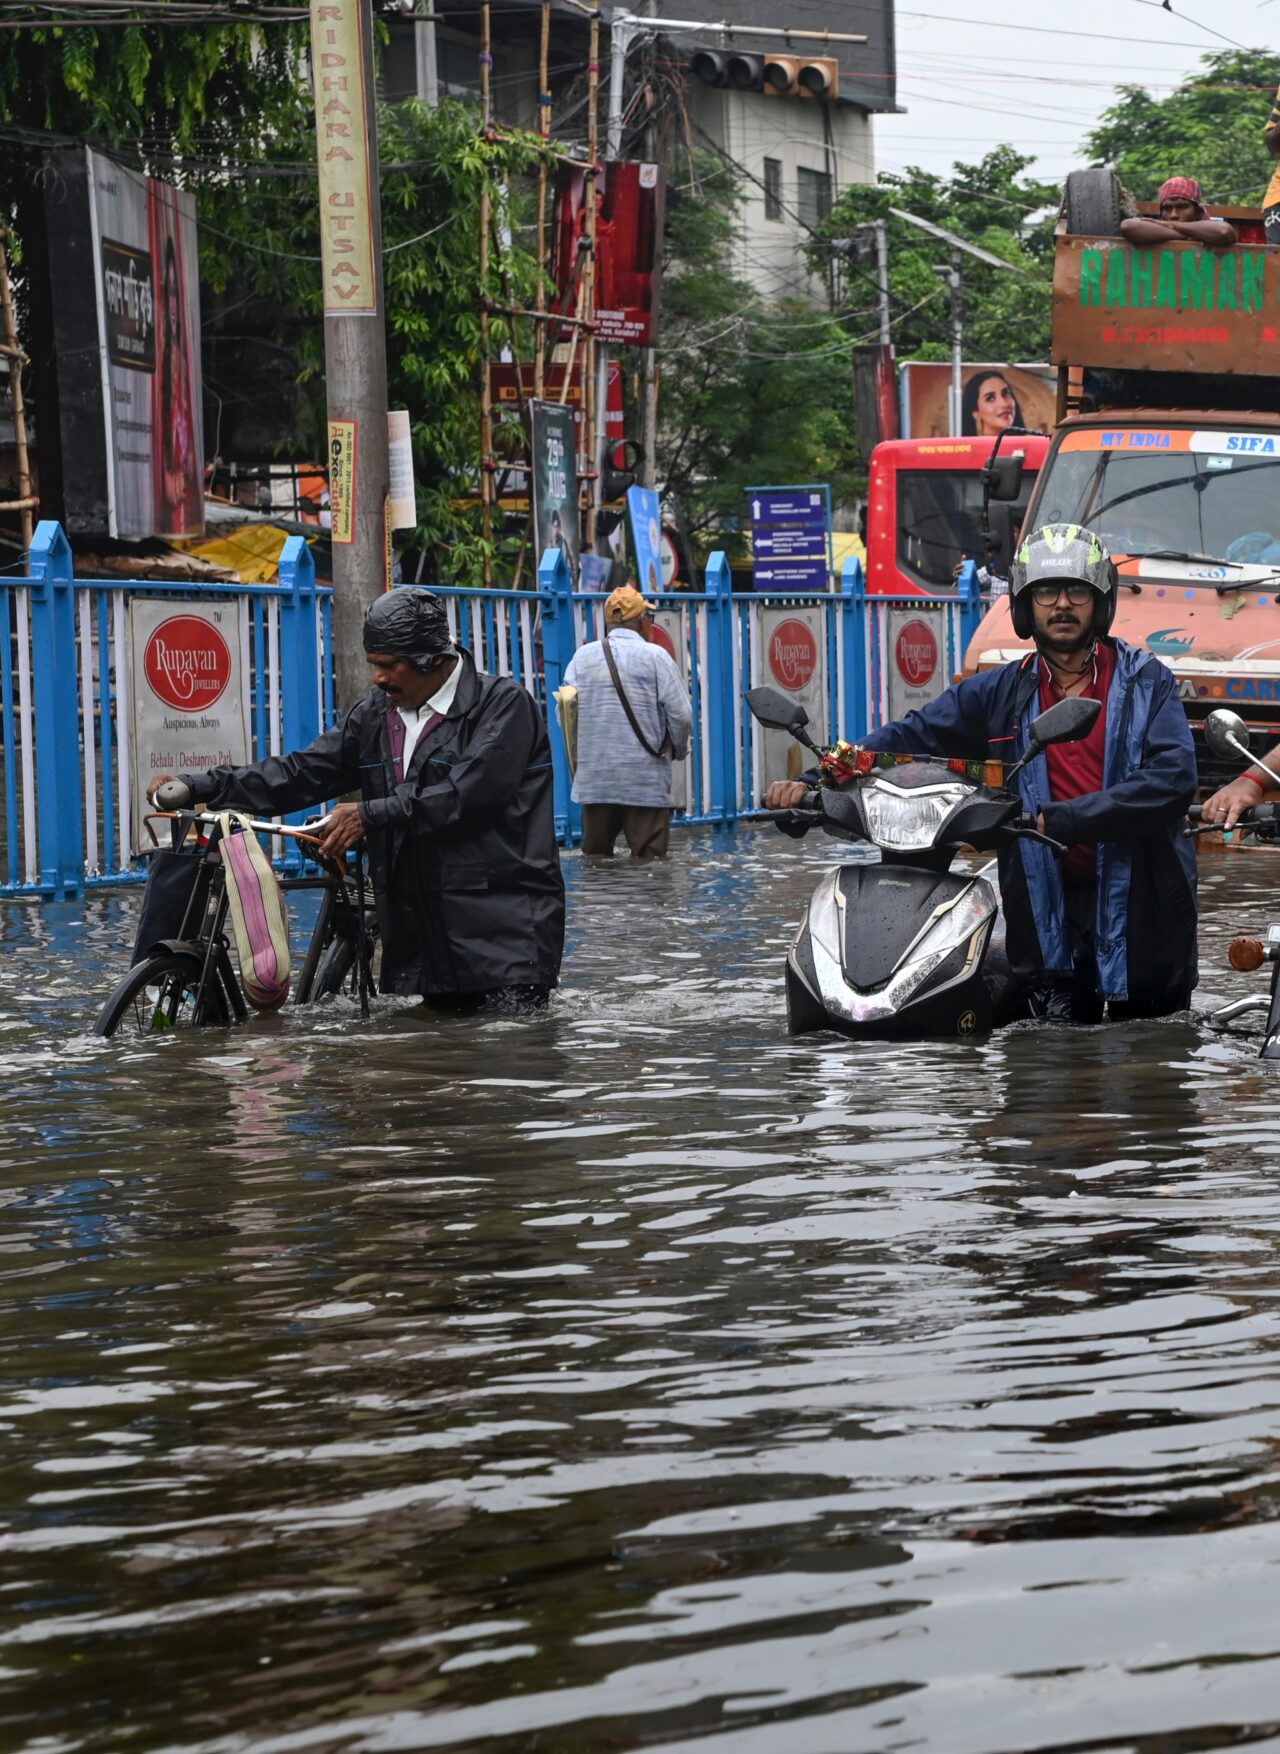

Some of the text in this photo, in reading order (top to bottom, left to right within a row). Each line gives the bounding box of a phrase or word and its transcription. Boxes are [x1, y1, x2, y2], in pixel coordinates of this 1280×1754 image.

[328, 192, 360, 299] UTSAV
[1079, 247, 1265, 311] RAHAMAN
[1100, 432, 1171, 448] MY INDIA
[1226, 436, 1275, 453] SIFA
[330, 438, 343, 535] executive
[549, 471, 567, 499] AUG
[213, 611, 221, 623] TM
[155, 638, 217, 700] Rupayan
[774, 636, 810, 682] Rupayan
[901, 637, 932, 679] Rupayan
[193, 679, 220, 690] JEWELLERS
[163, 715, 221, 732] Auspicious, Always
[150, 752, 174, 768] Behala
[179, 750, 217, 771] Deshapriya
[218, 750, 233, 766] Park
